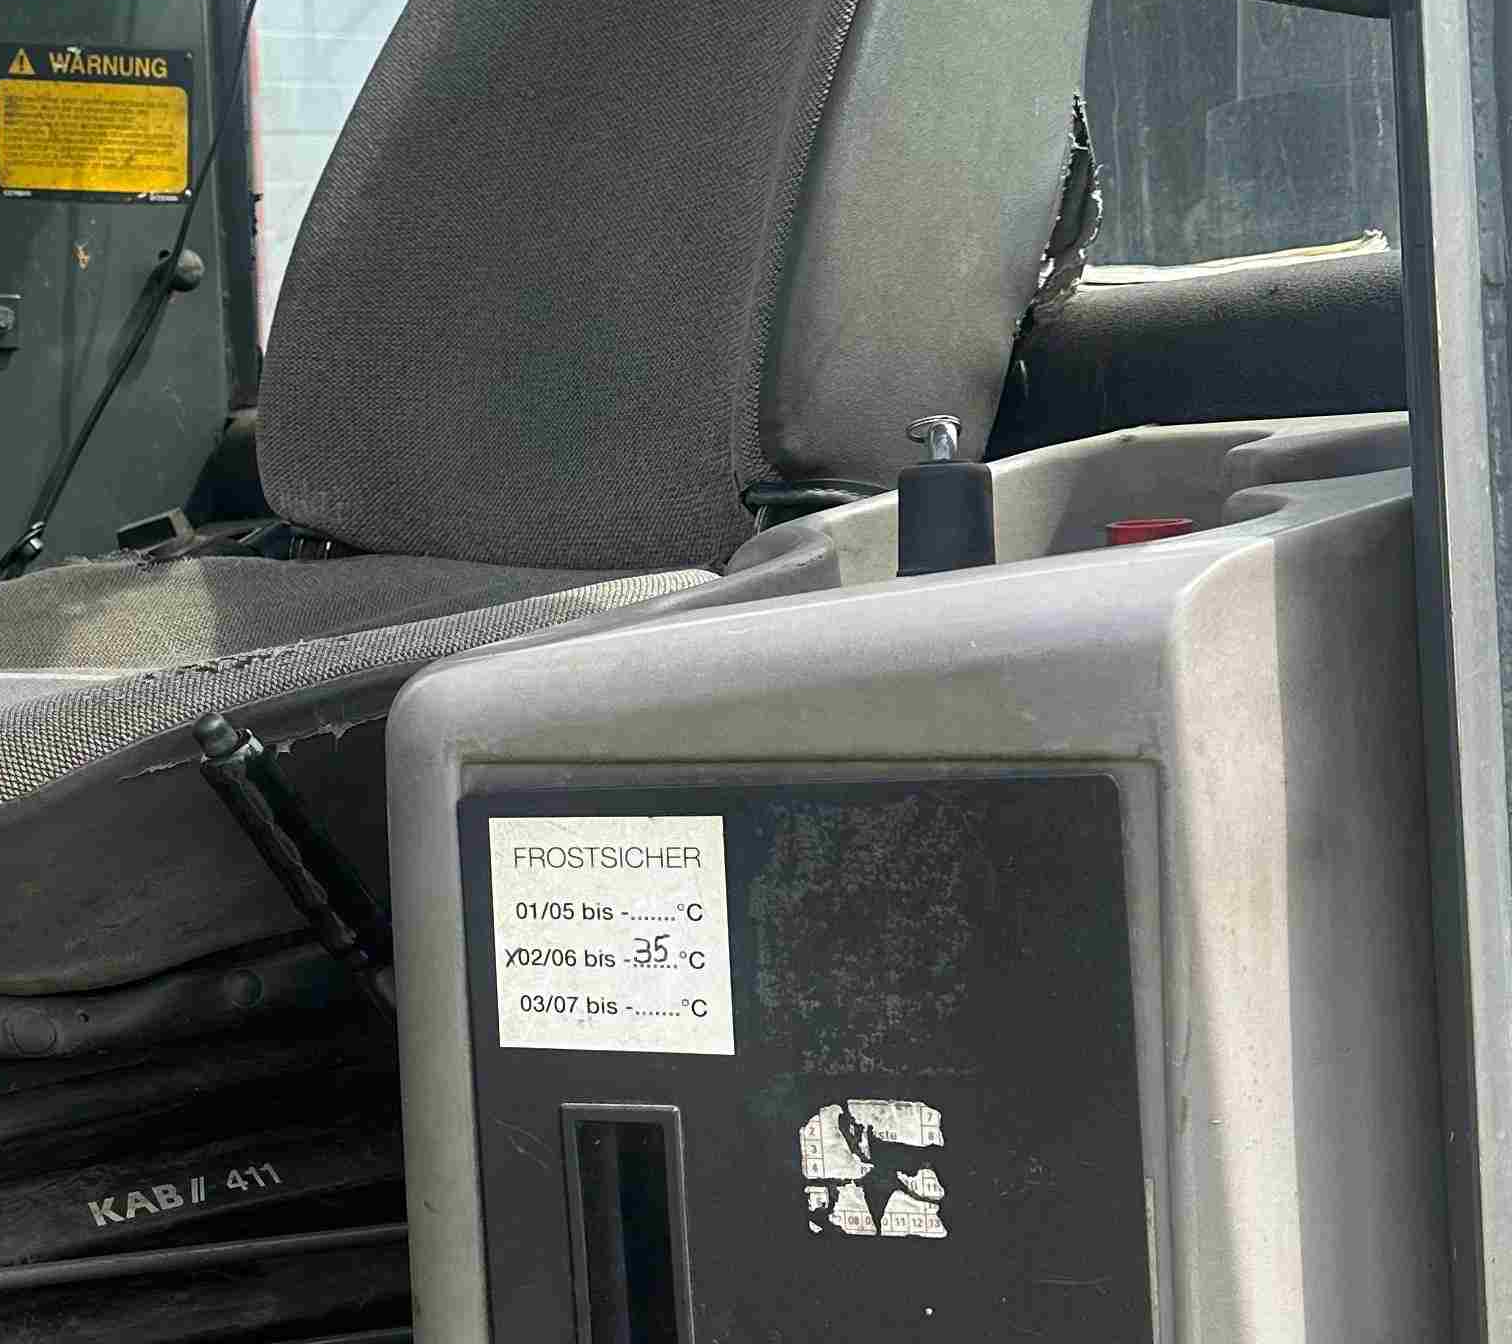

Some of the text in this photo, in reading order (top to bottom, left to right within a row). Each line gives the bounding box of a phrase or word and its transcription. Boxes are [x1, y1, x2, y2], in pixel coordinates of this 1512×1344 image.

[48, 51, 168, 78] WARNUNG
[514, 846, 701, 869] FROSTSICHER
[516, 902, 575, 920] 01/05
[582, 903, 614, 920] bis
[584, 949, 616, 968] bis
[520, 995, 578, 1014] 03/07
[586, 996, 618, 1015] bis
[88, 1184, 184, 1226] KAB
[226, 1163, 282, 1191] 411
